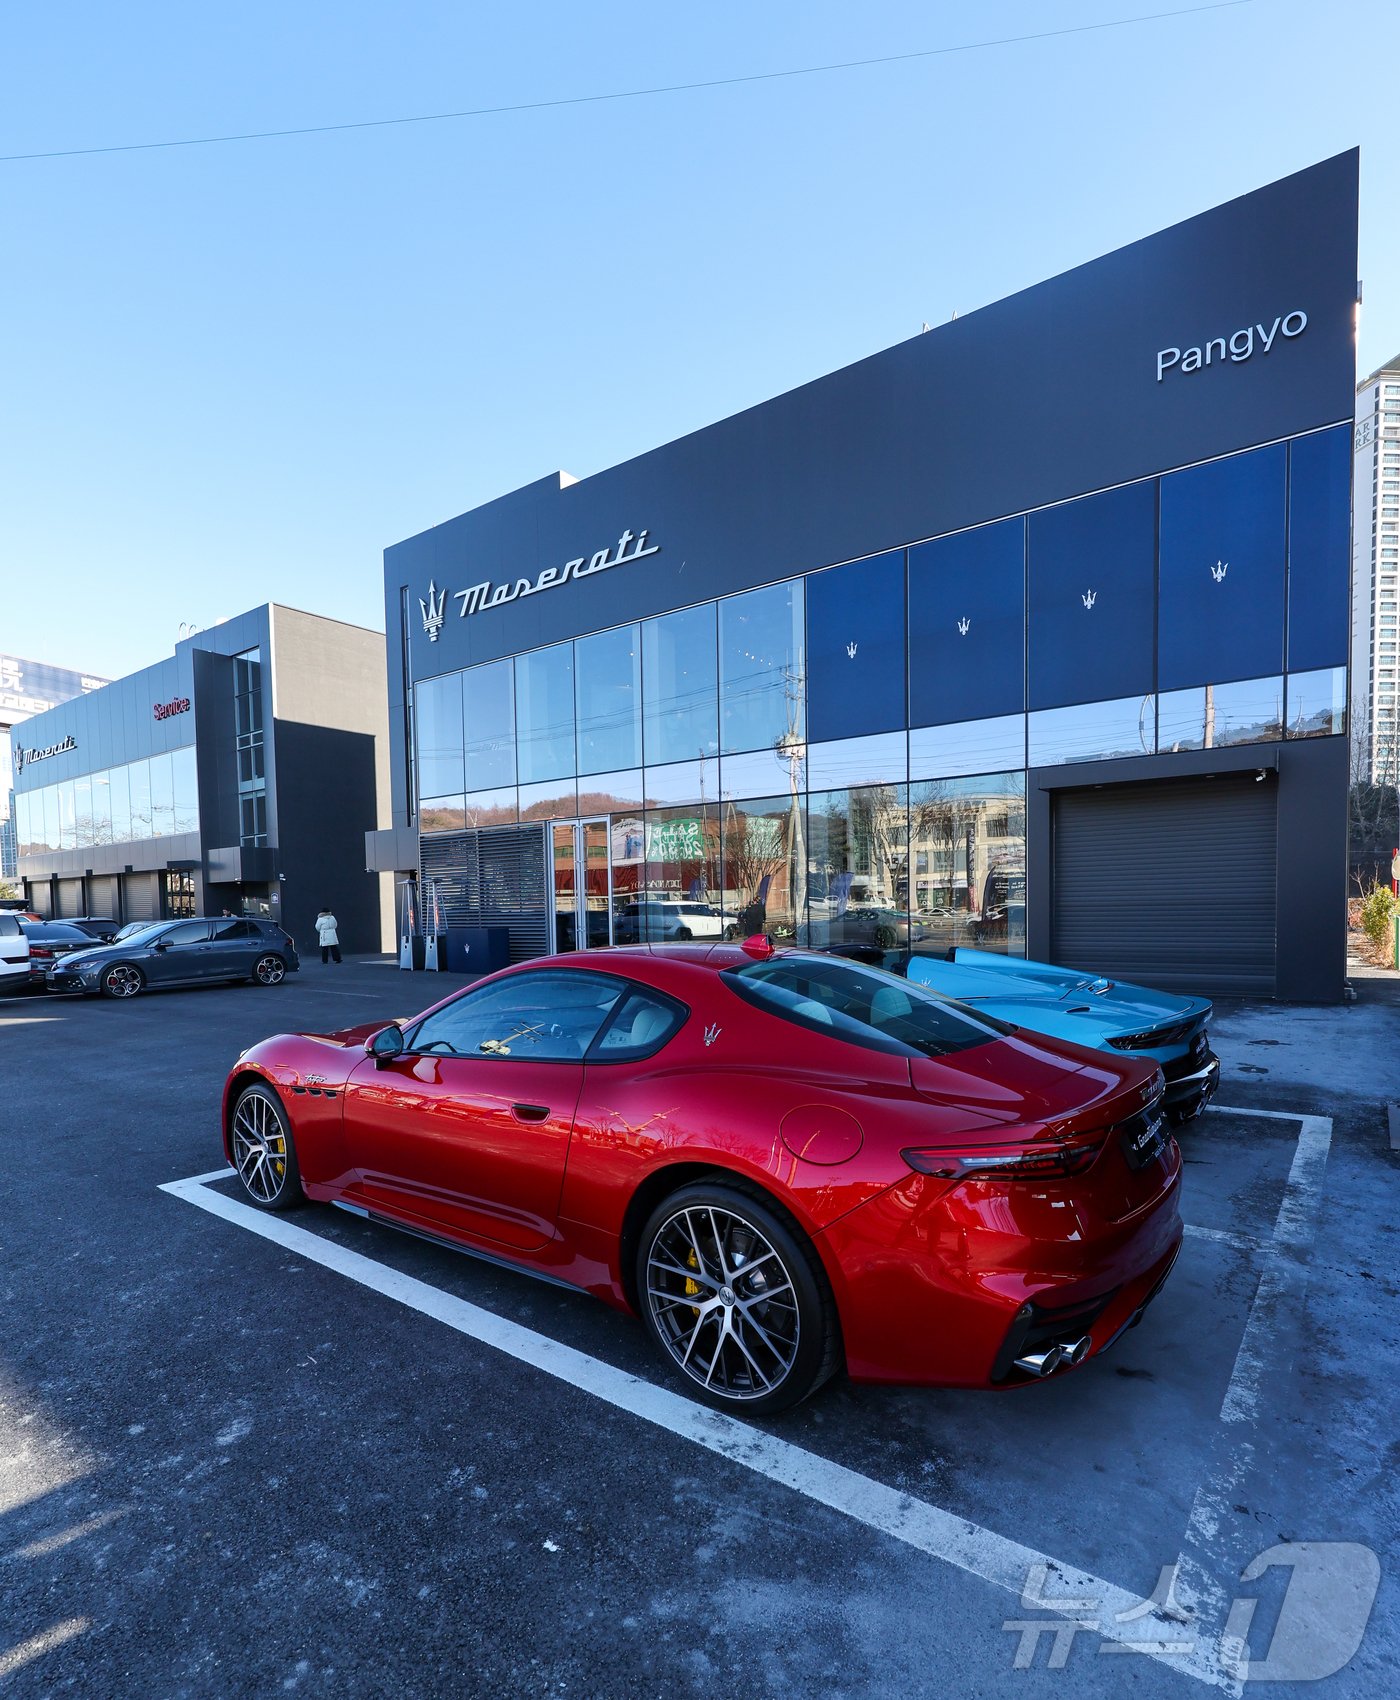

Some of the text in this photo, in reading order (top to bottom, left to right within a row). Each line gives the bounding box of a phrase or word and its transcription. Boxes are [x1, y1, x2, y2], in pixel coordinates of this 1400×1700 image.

[1157, 310, 1308, 381] Pangyo
[453, 529, 659, 617] Maserati
[153, 697, 190, 721] Service
[22, 735, 78, 765] Maserati
